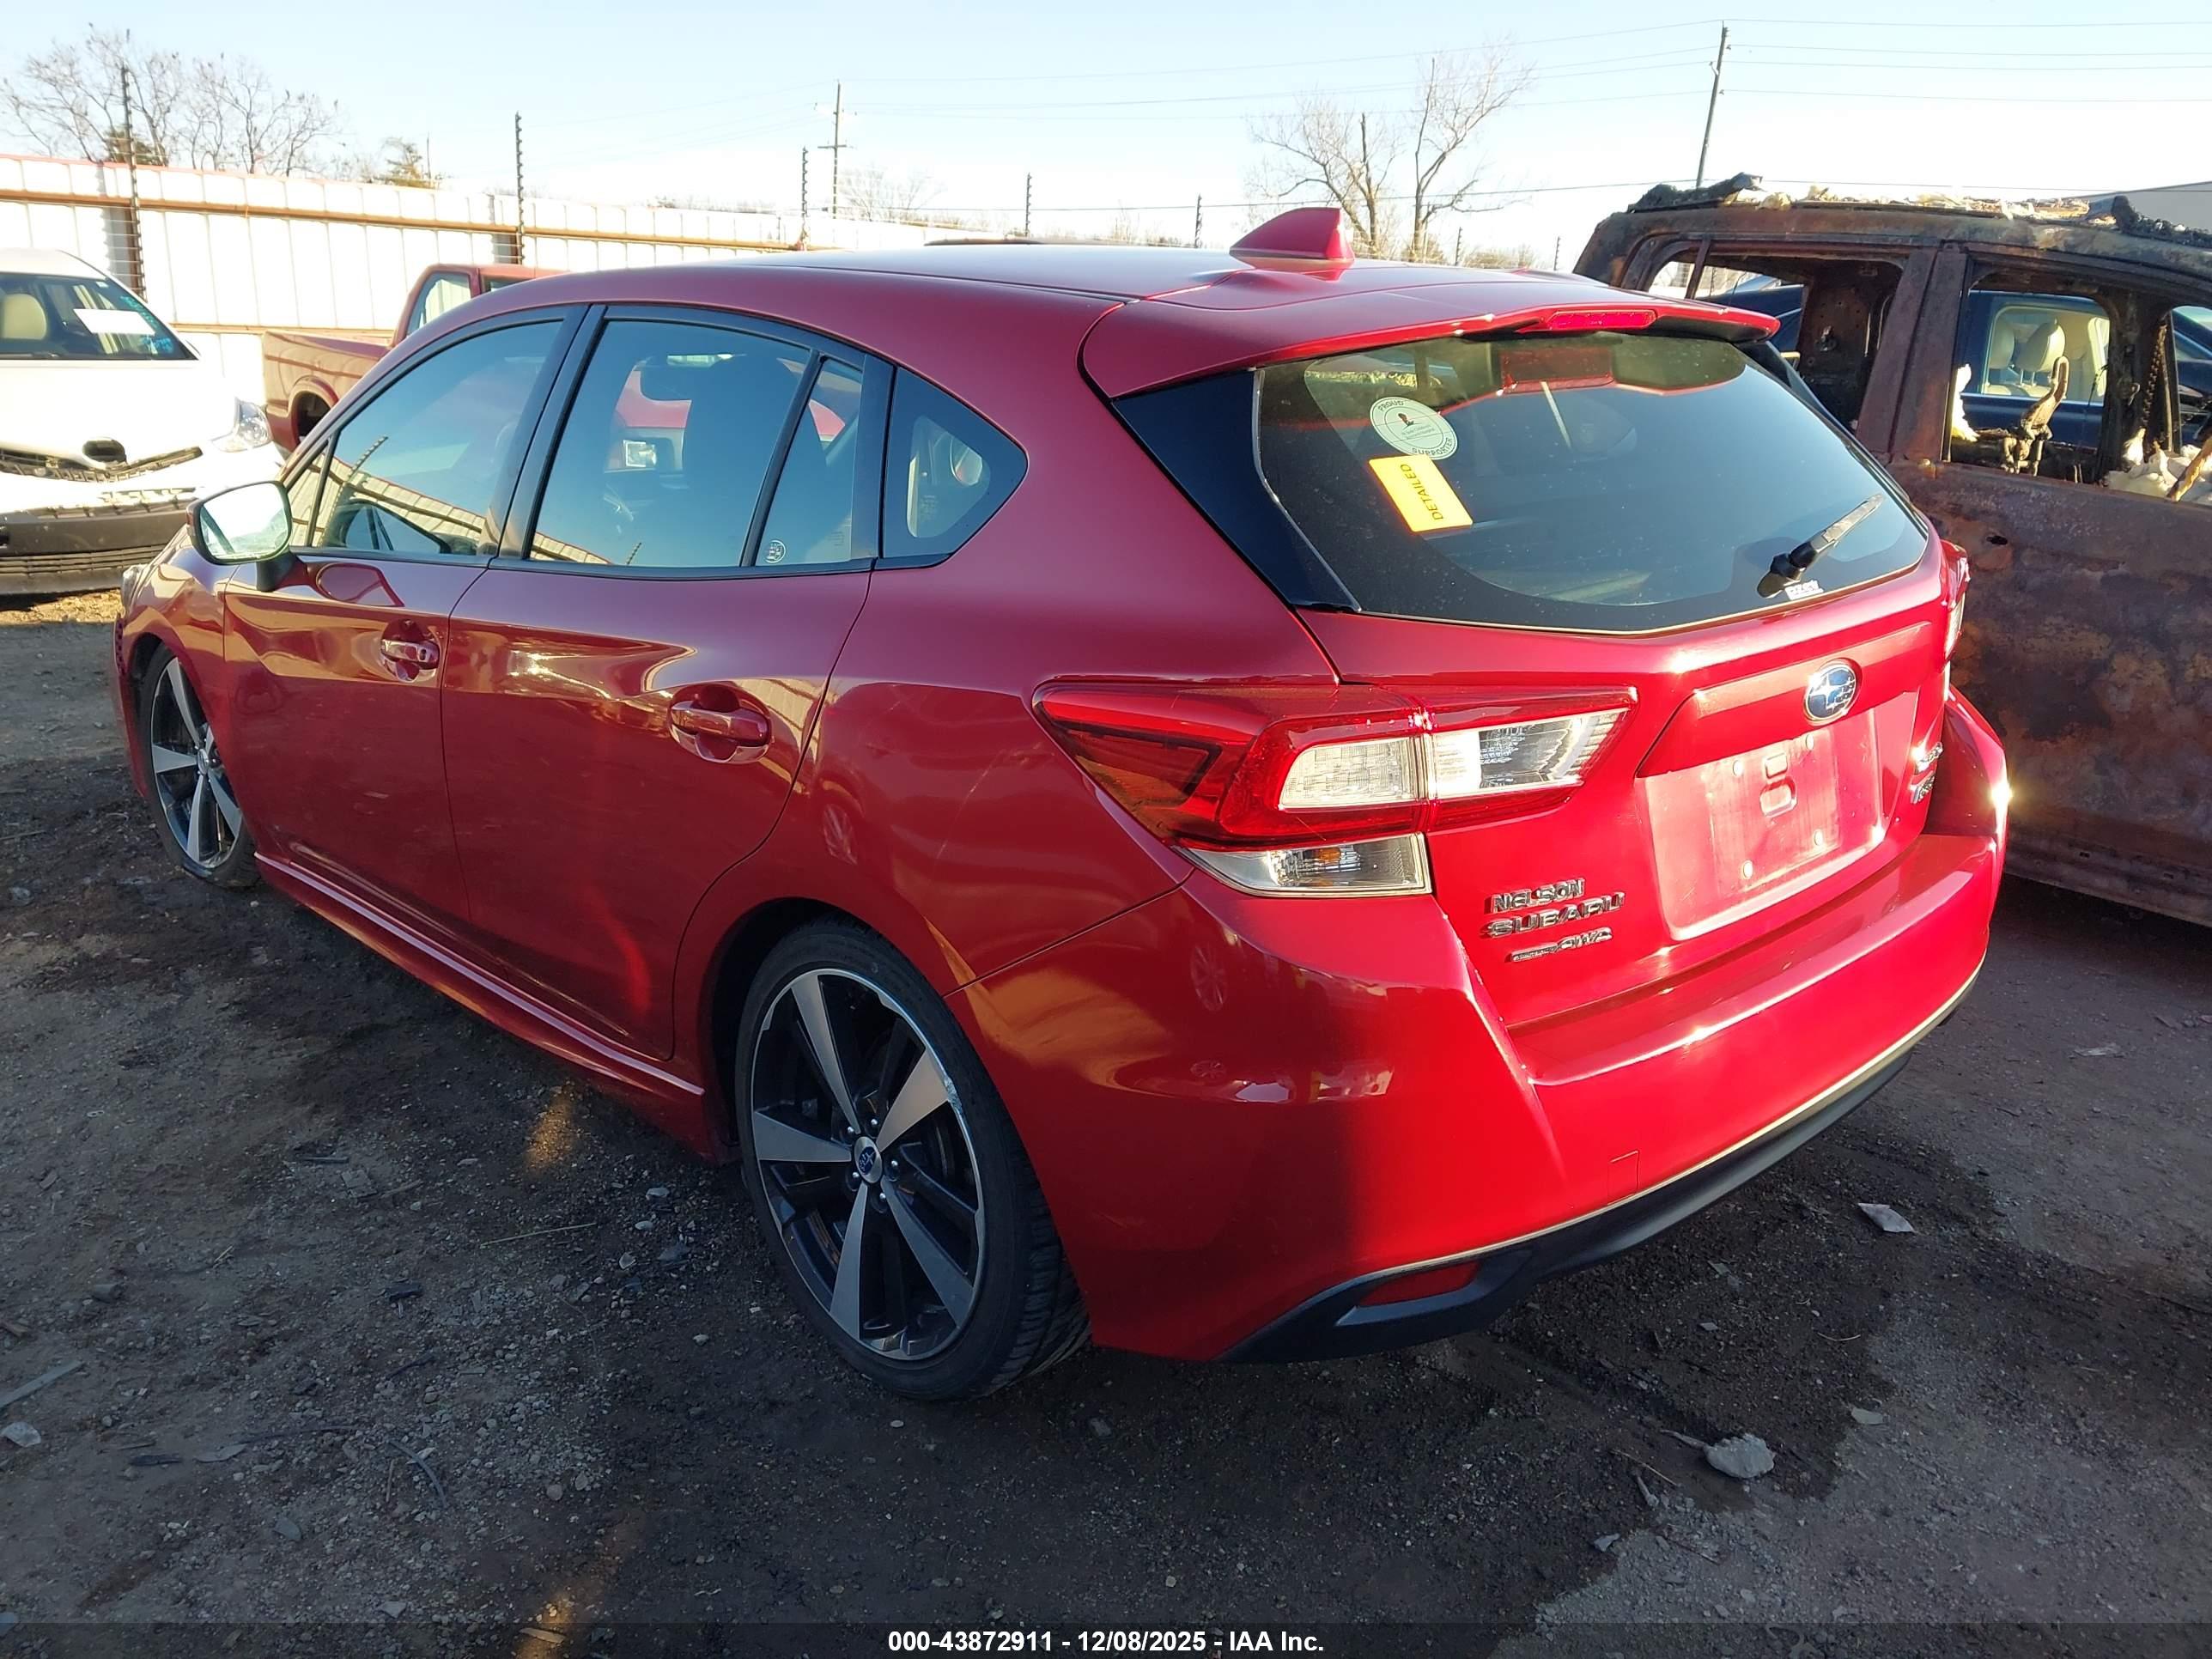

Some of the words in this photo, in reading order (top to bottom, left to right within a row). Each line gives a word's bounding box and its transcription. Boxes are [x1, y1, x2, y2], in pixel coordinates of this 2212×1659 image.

[1377, 400, 1405, 412] PROUD
[1412, 436, 1453, 456] SUPPORTER
[1400, 464, 1443, 520] DETAILED
[1491, 878, 1585, 914] NELSON
[1486, 891, 1626, 939] SUBARU
